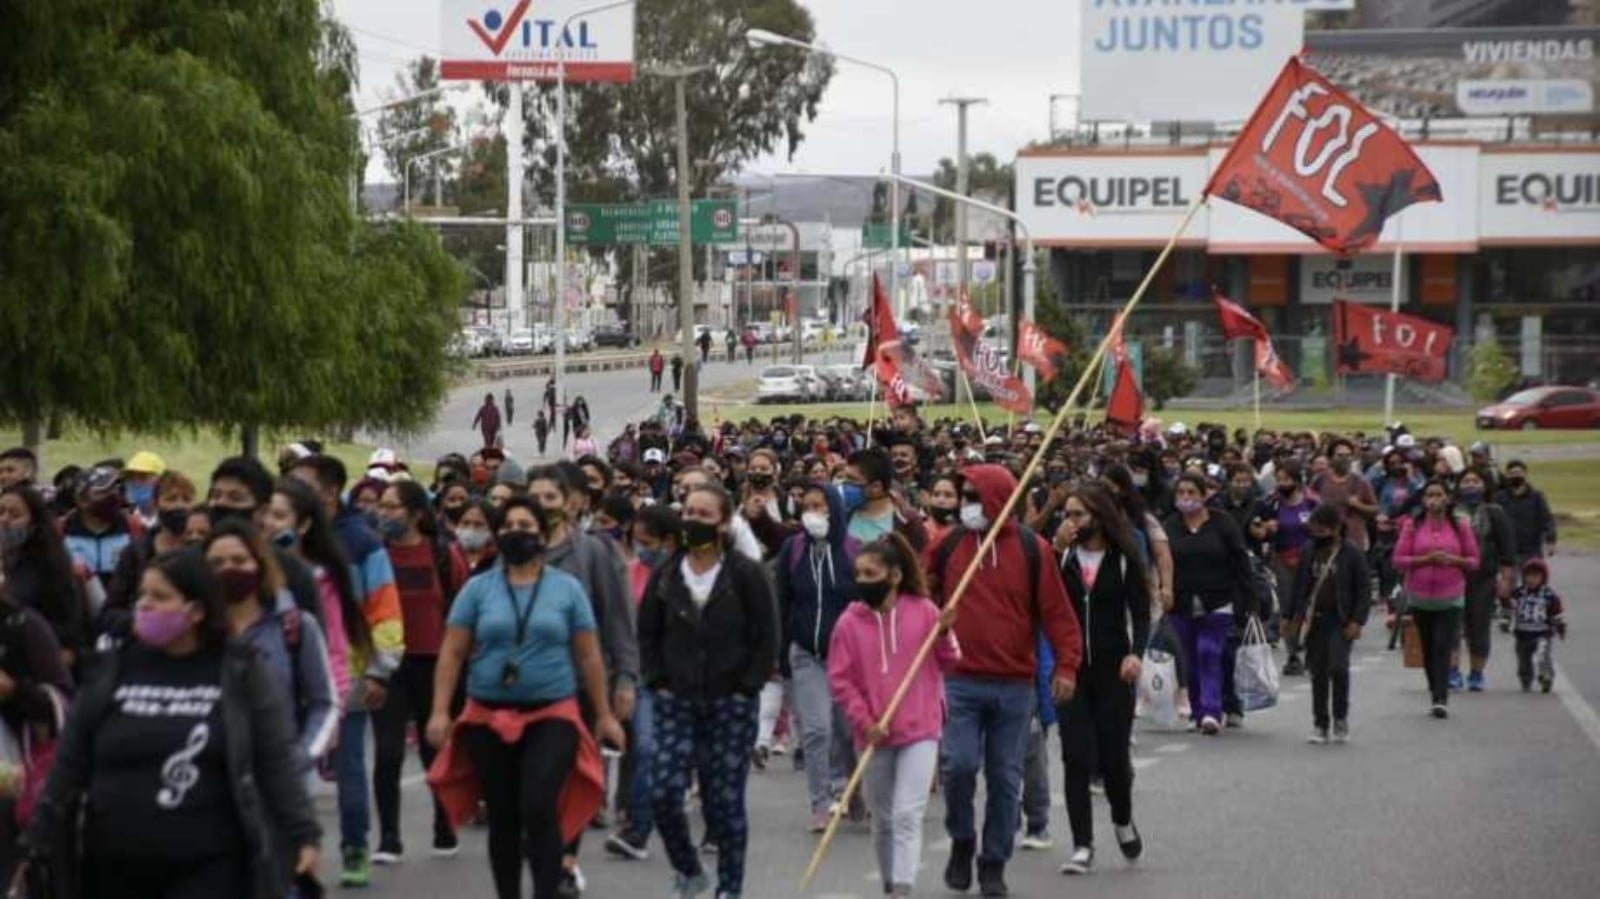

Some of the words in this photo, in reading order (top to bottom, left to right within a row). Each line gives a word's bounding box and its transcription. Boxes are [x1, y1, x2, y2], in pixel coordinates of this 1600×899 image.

[1095, 14, 1264, 51] JUNTOS
[1462, 38, 1594, 64] VIVIENDAS
[1262, 82, 1379, 207] FOL
[1034, 175, 1190, 210] EQUIPEL
[1496, 173, 1600, 206] EQUI
